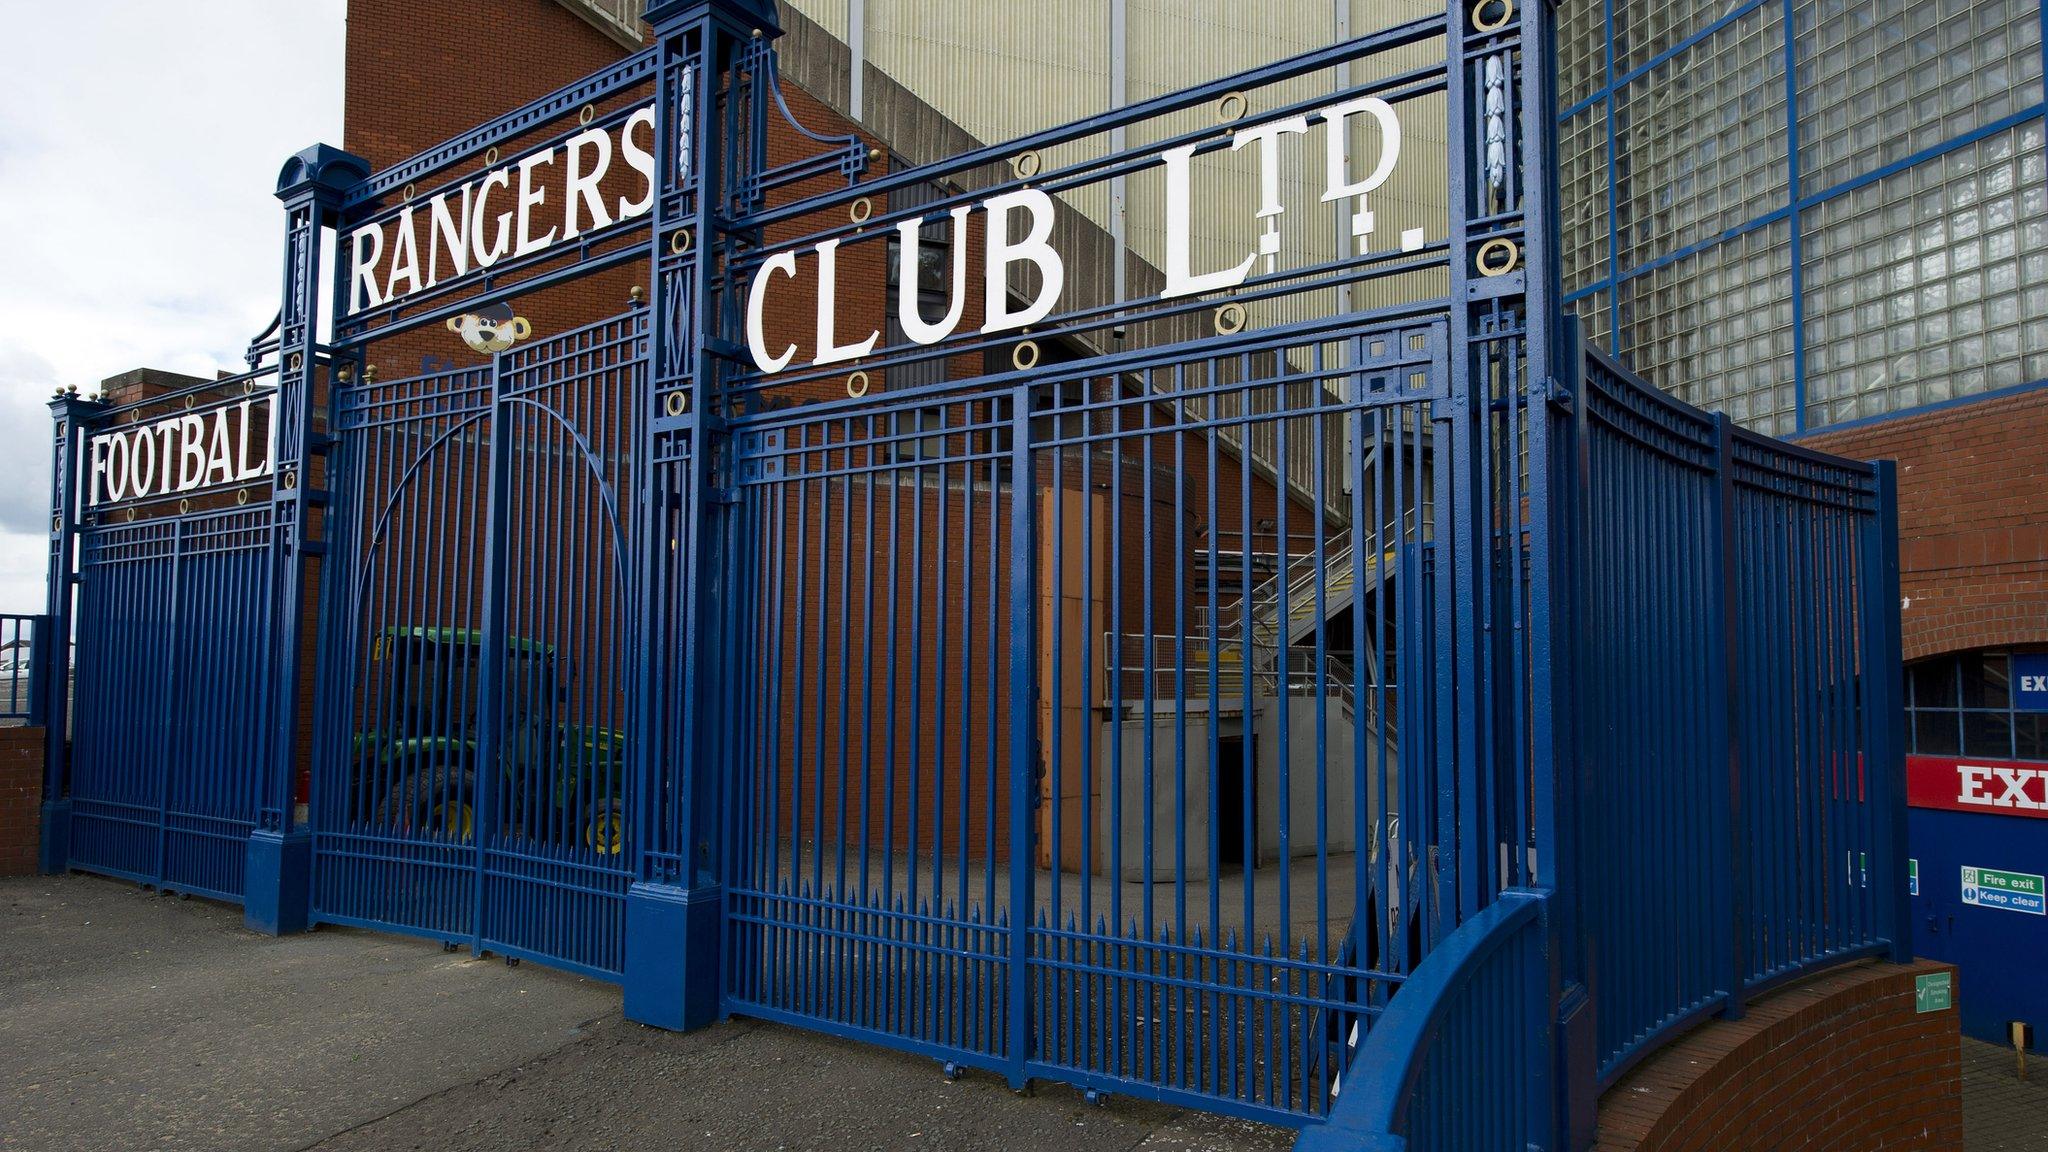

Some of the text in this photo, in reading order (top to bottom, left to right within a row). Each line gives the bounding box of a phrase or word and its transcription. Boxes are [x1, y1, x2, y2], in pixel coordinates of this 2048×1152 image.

[348, 103, 655, 316] RANGERS
[746, 188, 1064, 374] CLUB
[2021, 675, 2048, 692] EX
[1984, 873, 2034, 890] Fire exit
[1980, 890, 2040, 908] Keep clear
